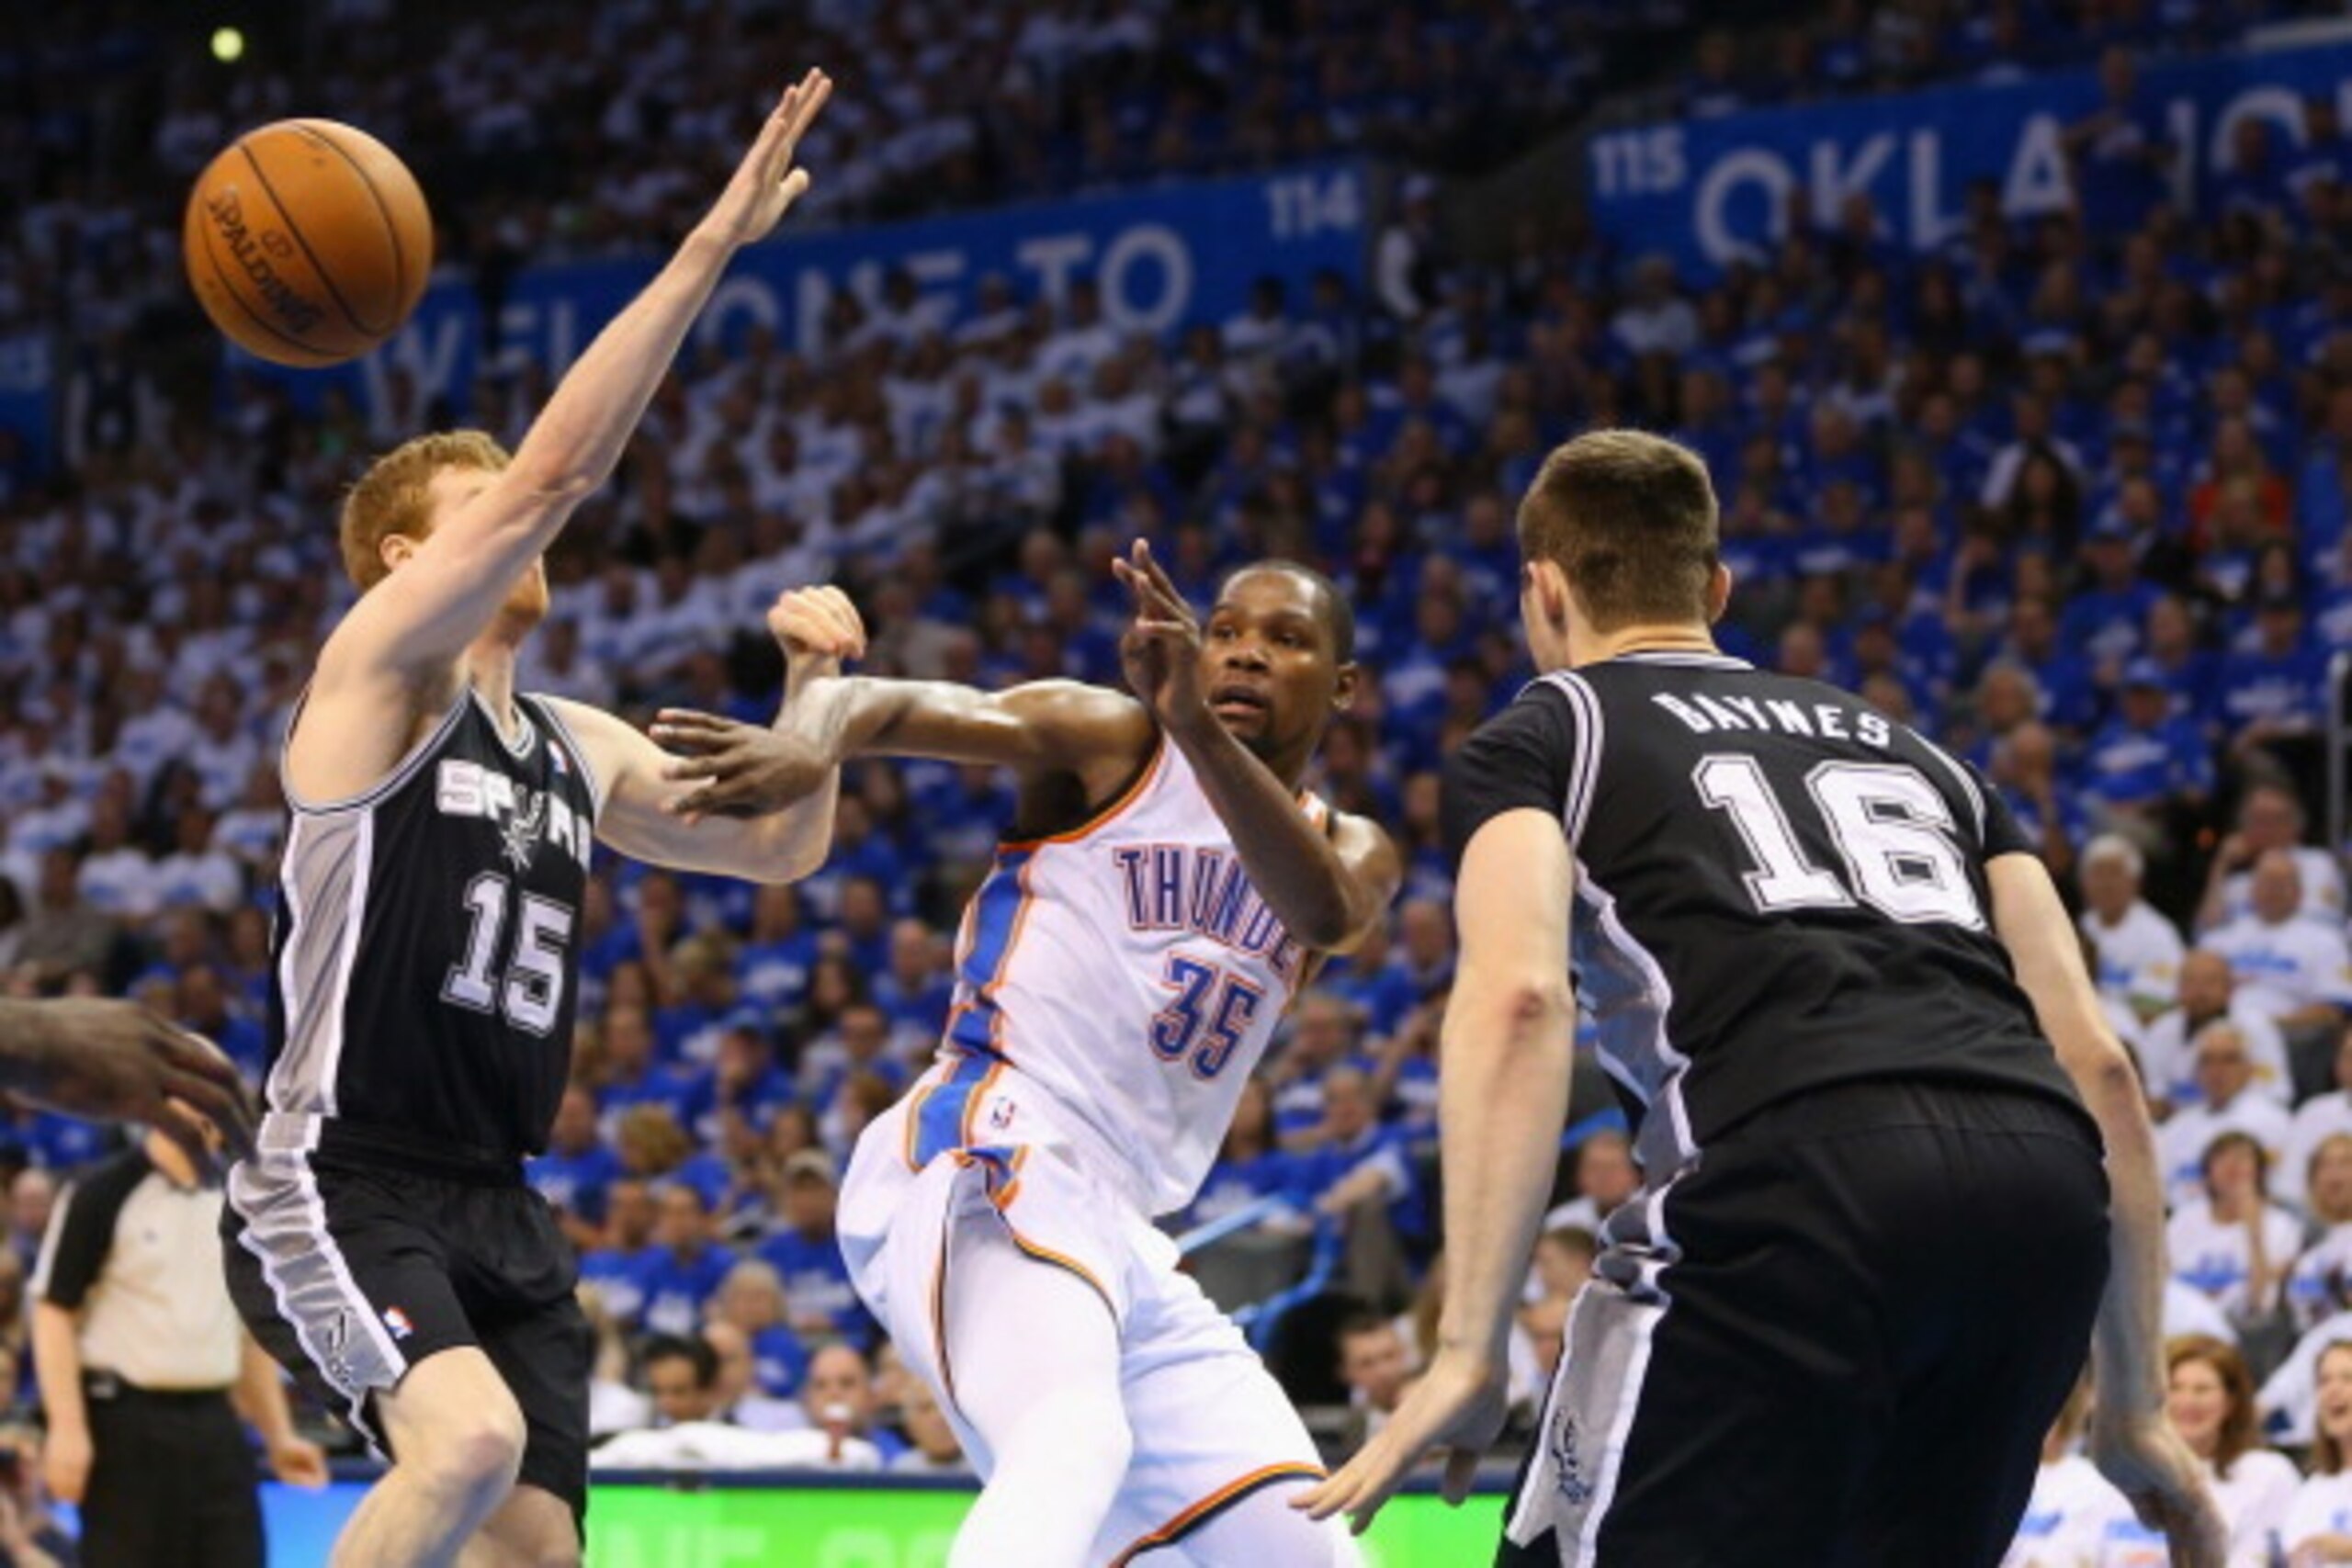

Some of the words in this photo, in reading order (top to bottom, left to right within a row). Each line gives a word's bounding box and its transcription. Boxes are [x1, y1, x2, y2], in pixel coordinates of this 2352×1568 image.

[1266, 173, 1363, 241] 114
[1589, 127, 1689, 197] 115
[1017, 223, 1196, 338] TO
[1651, 692, 1890, 749] BAYNES
[1691, 751, 1989, 931] 16
[438, 870, 576, 1039] 15
[1148, 949, 1269, 1082] 35
